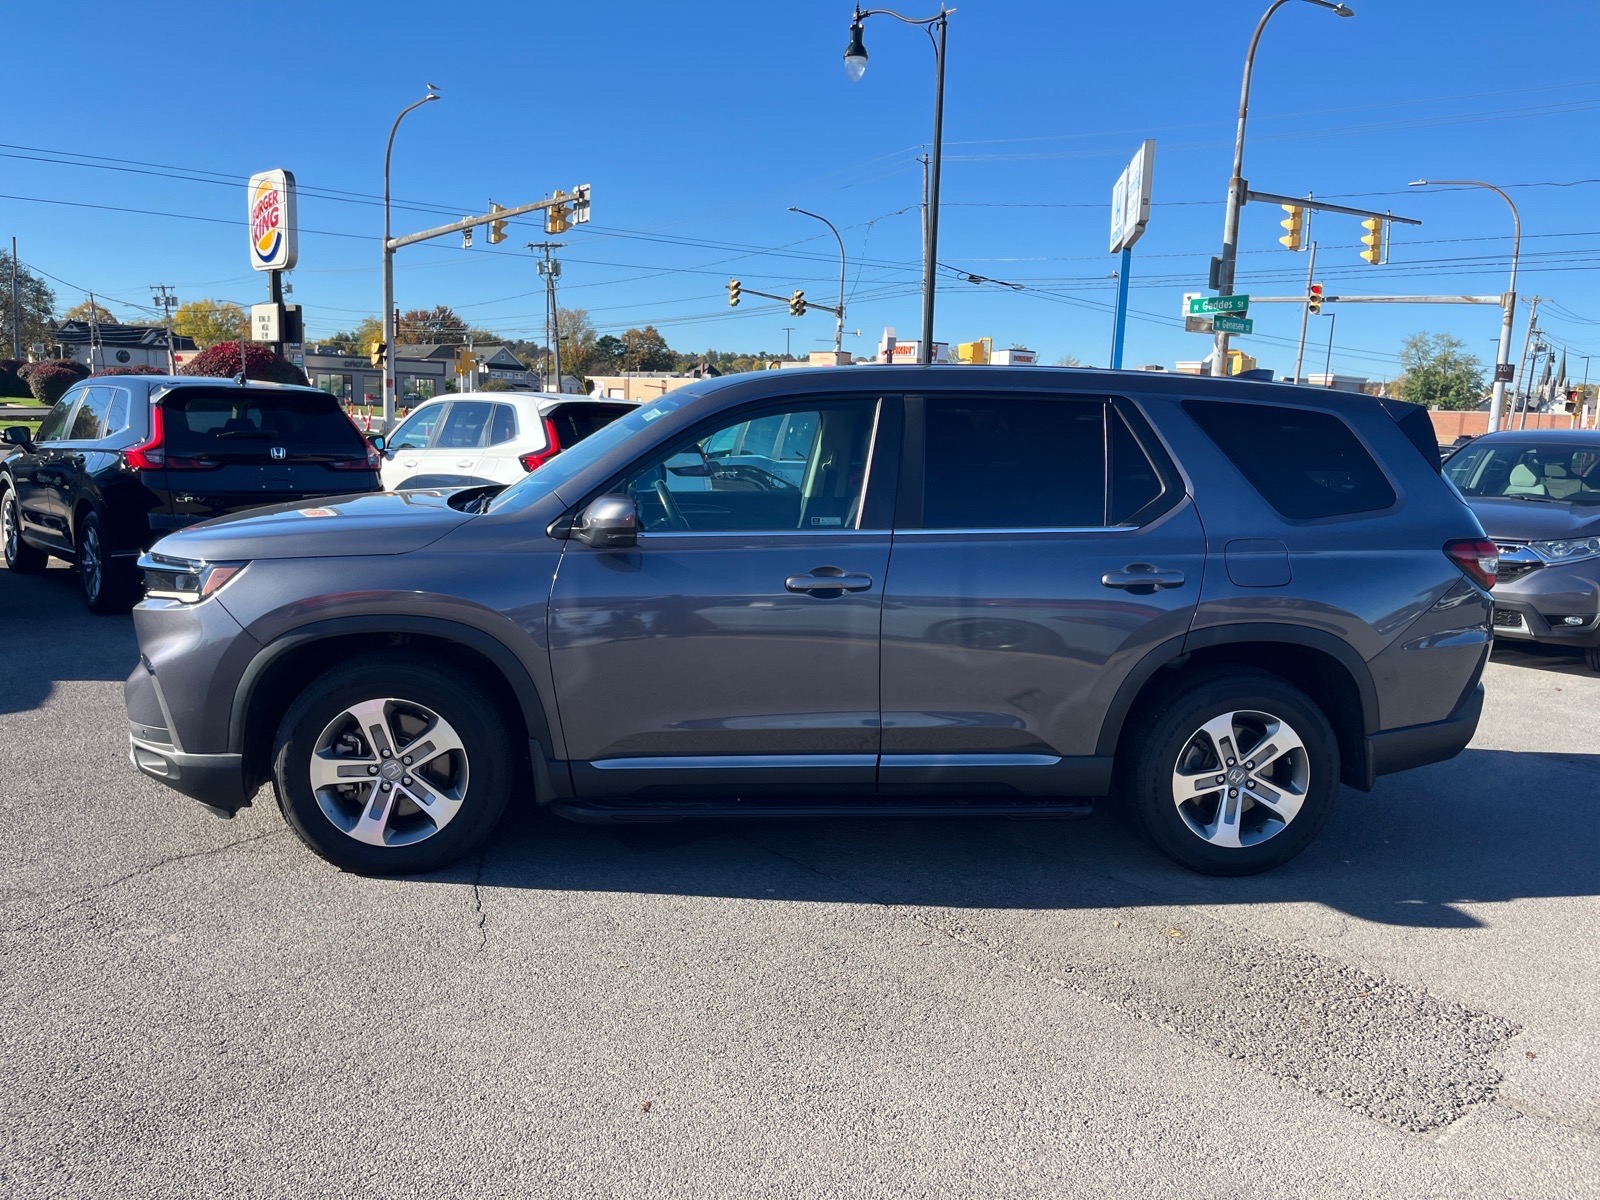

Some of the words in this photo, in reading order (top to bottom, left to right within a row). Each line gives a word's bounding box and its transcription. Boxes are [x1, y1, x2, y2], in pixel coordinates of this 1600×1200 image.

[253, 190, 278, 225] BURGER
[254, 206, 279, 244] KING
[1203, 300, 1233, 311] Geddes
[1222, 319, 1244, 331] Genesee
[1498, 365, 1513, 373] ZOO
